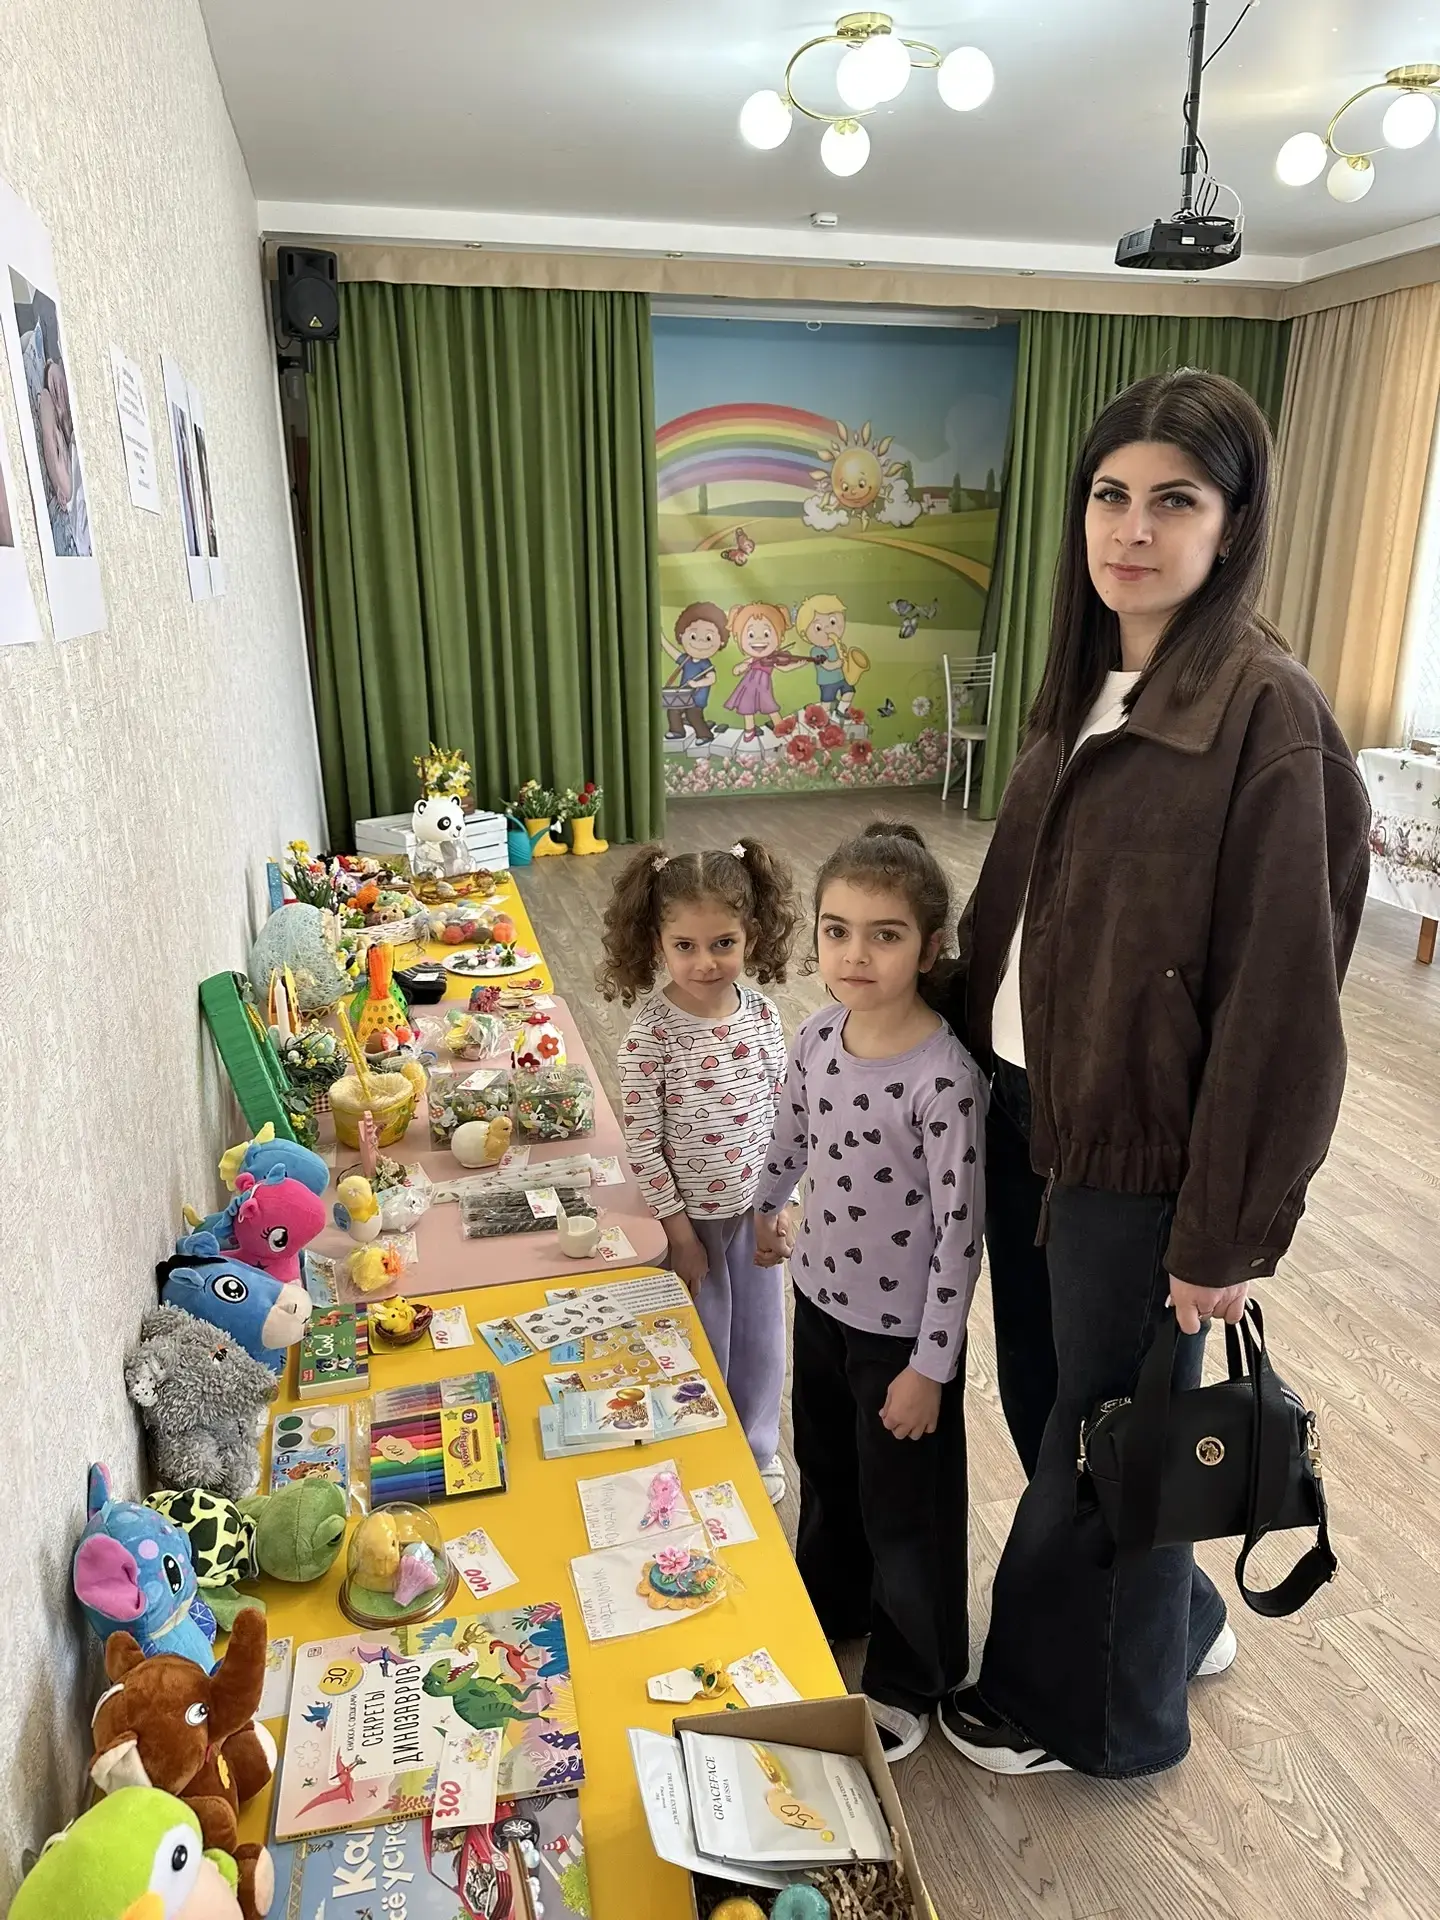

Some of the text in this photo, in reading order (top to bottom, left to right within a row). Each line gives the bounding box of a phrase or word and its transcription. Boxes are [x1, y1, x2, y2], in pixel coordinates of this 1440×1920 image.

[313, 1333, 335, 1357] Cool
[435, 1330, 449, 1345] 150
[658, 1355, 676, 1370] 150
[463, 1568, 492, 1593] 400
[322, 1667, 348, 1686] 30
[361, 1689, 386, 1748] СЕКРЕТЫ
[392, 1665, 425, 1766] ДИНОЗАВРОВ
[346, 1726, 355, 1752] КНИЖКА
[435, 1780, 462, 1818] 300
[705, 1755, 725, 1821] GRACEFACE
[723, 1778, 733, 1803] RUSSIA
[391, 1809, 426, 1822] СЕКРЕТЫ
[780, 1804, 814, 1827] 50
